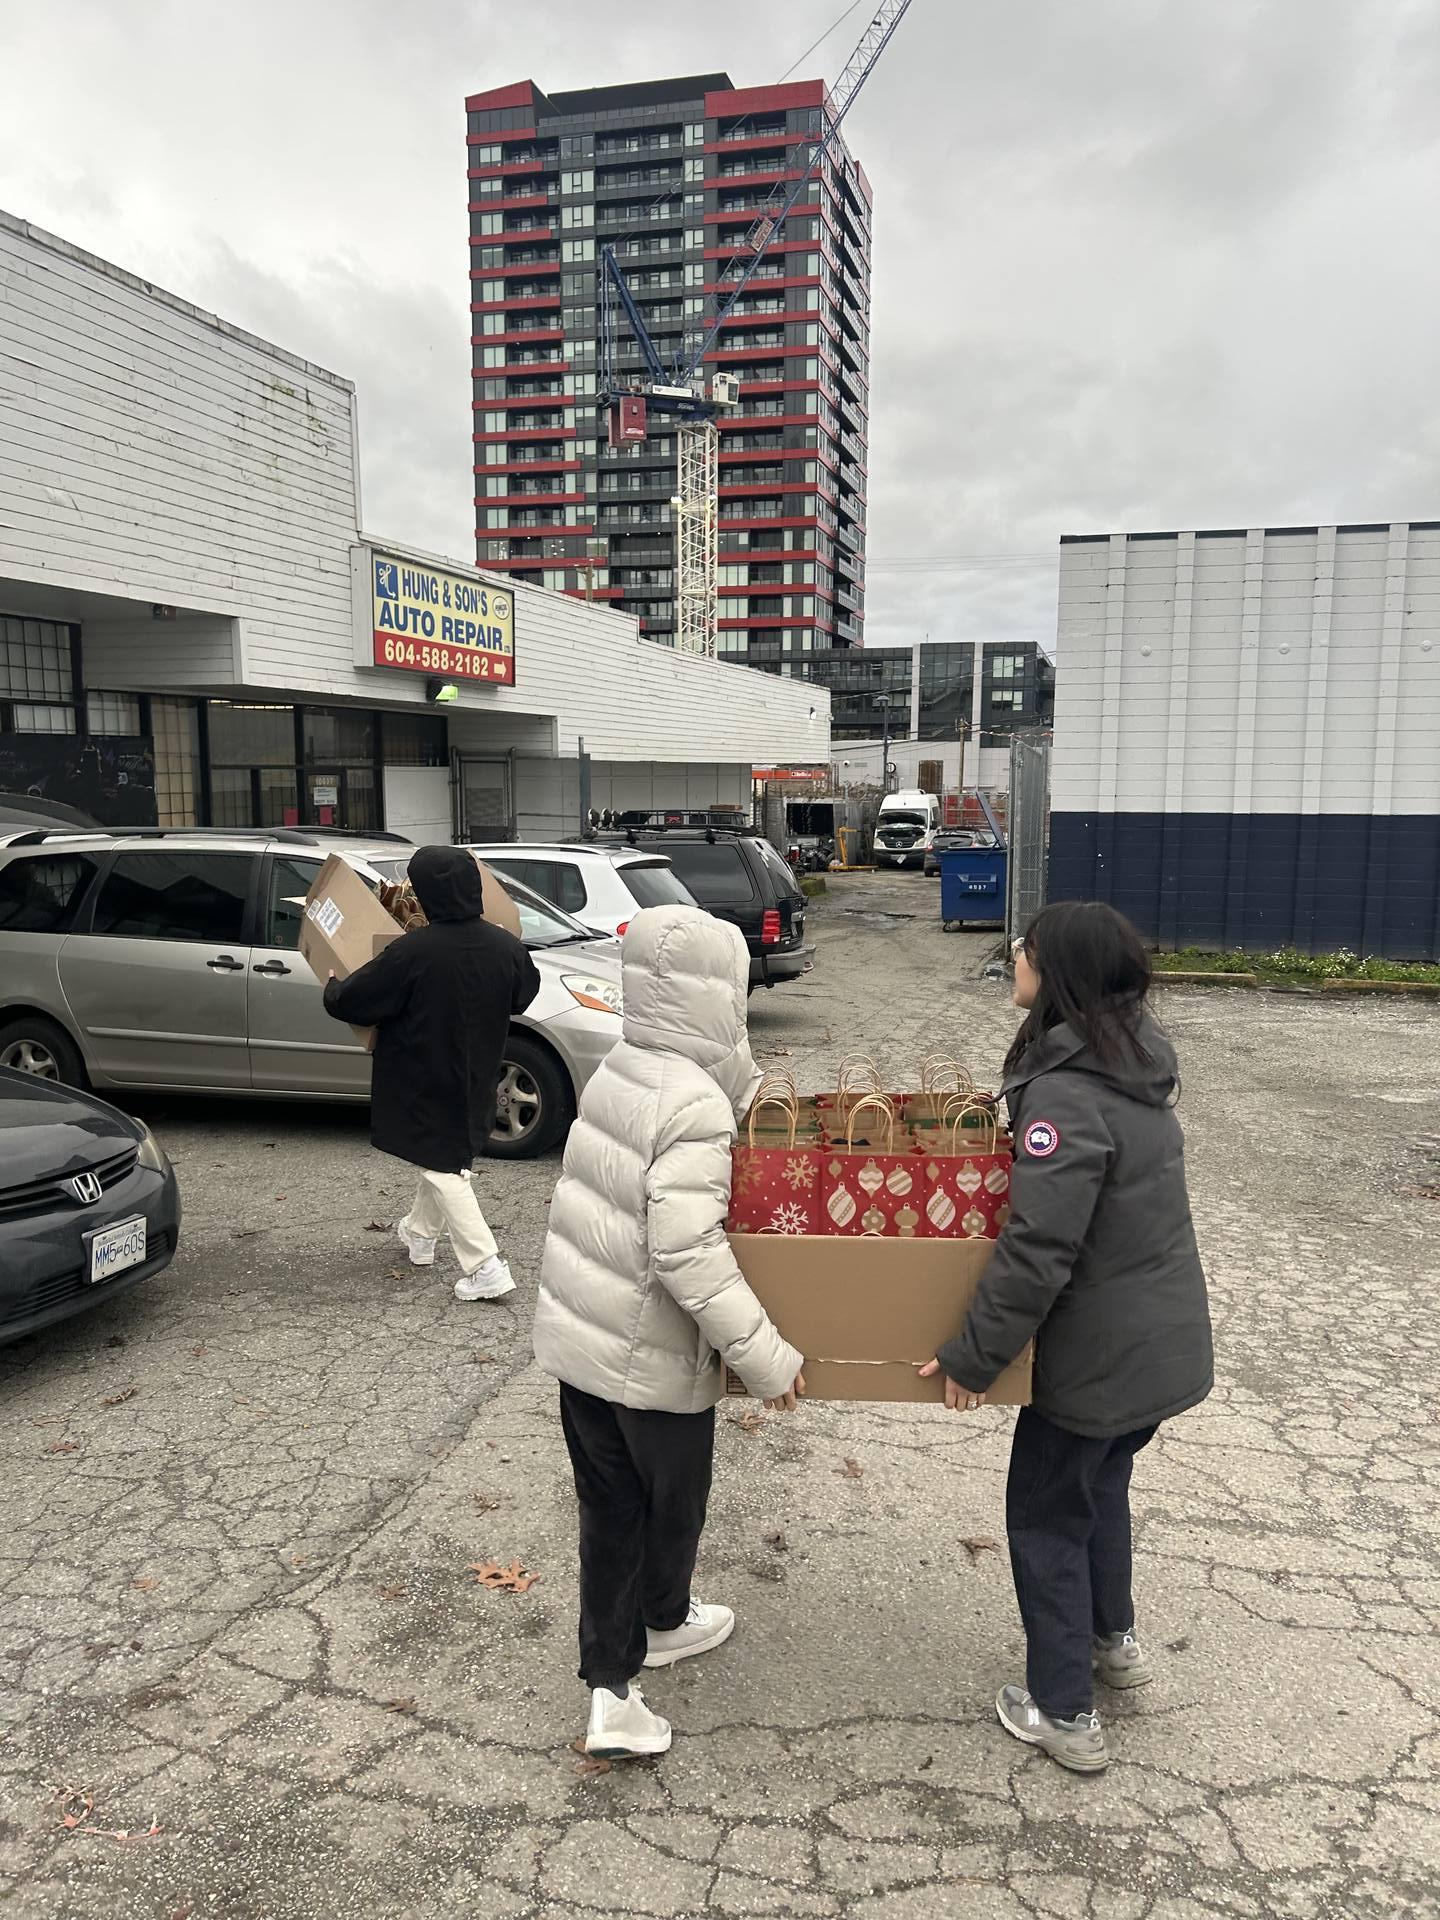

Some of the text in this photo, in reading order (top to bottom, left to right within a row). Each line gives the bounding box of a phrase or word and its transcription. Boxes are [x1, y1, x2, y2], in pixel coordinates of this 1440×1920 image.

[402, 568, 487, 616] HUNG & SON'S
[379, 601, 503, 651] AUTO REPAIR
[384, 639, 489, 676] 604-588-2182
[1028, 1708, 1040, 1725] N
